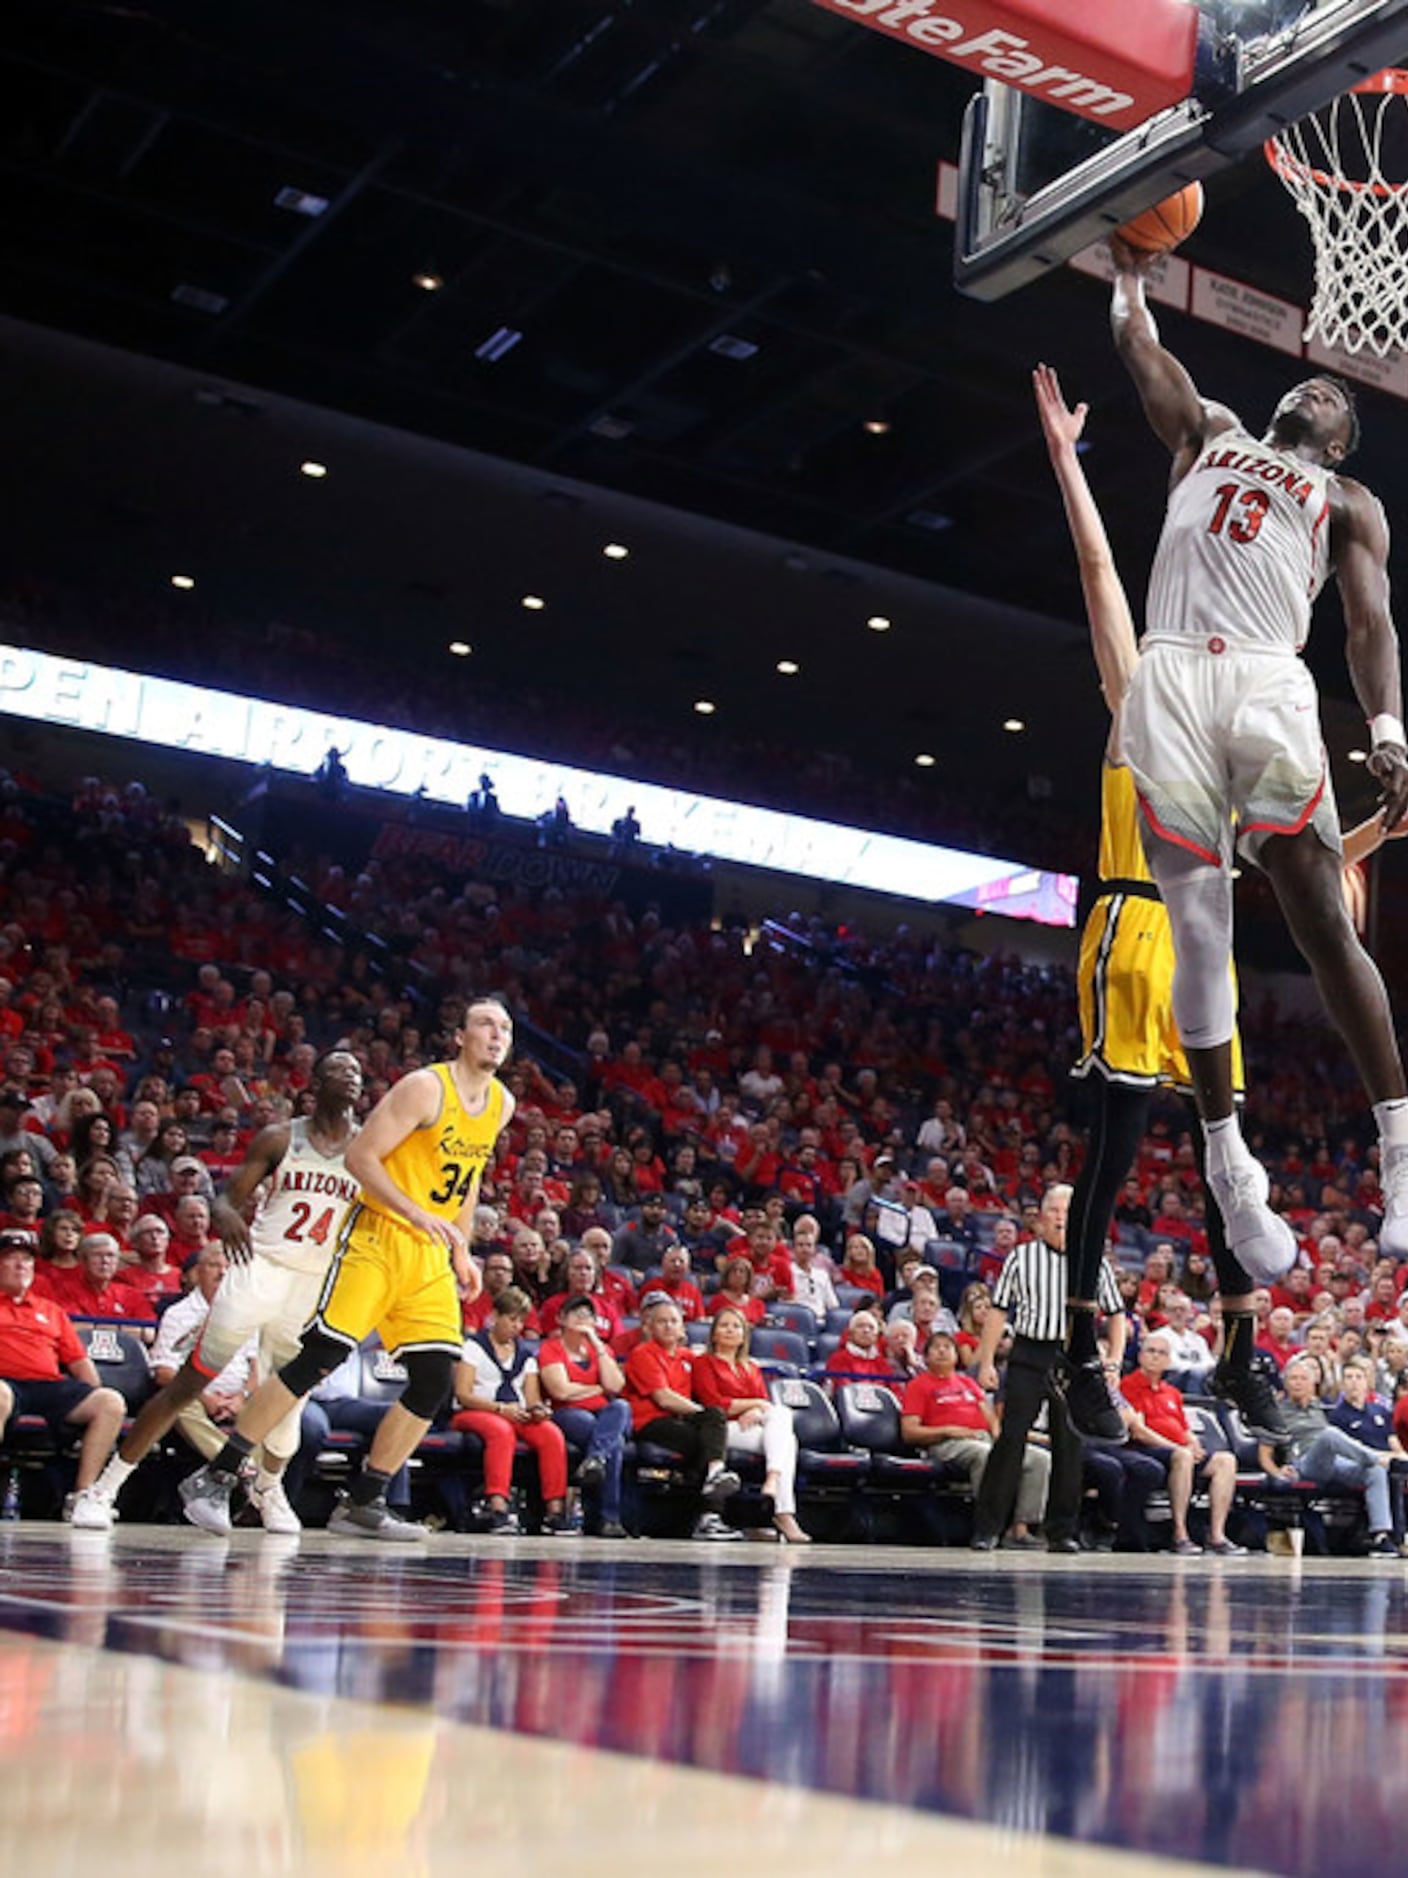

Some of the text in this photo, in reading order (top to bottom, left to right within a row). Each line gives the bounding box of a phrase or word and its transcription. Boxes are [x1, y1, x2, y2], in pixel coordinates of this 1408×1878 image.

[1197, 449, 1315, 509] ARIZONA
[1207, 484, 1270, 544] 13
[430, 1163, 477, 1208] 34
[283, 1201, 336, 1246] 24
